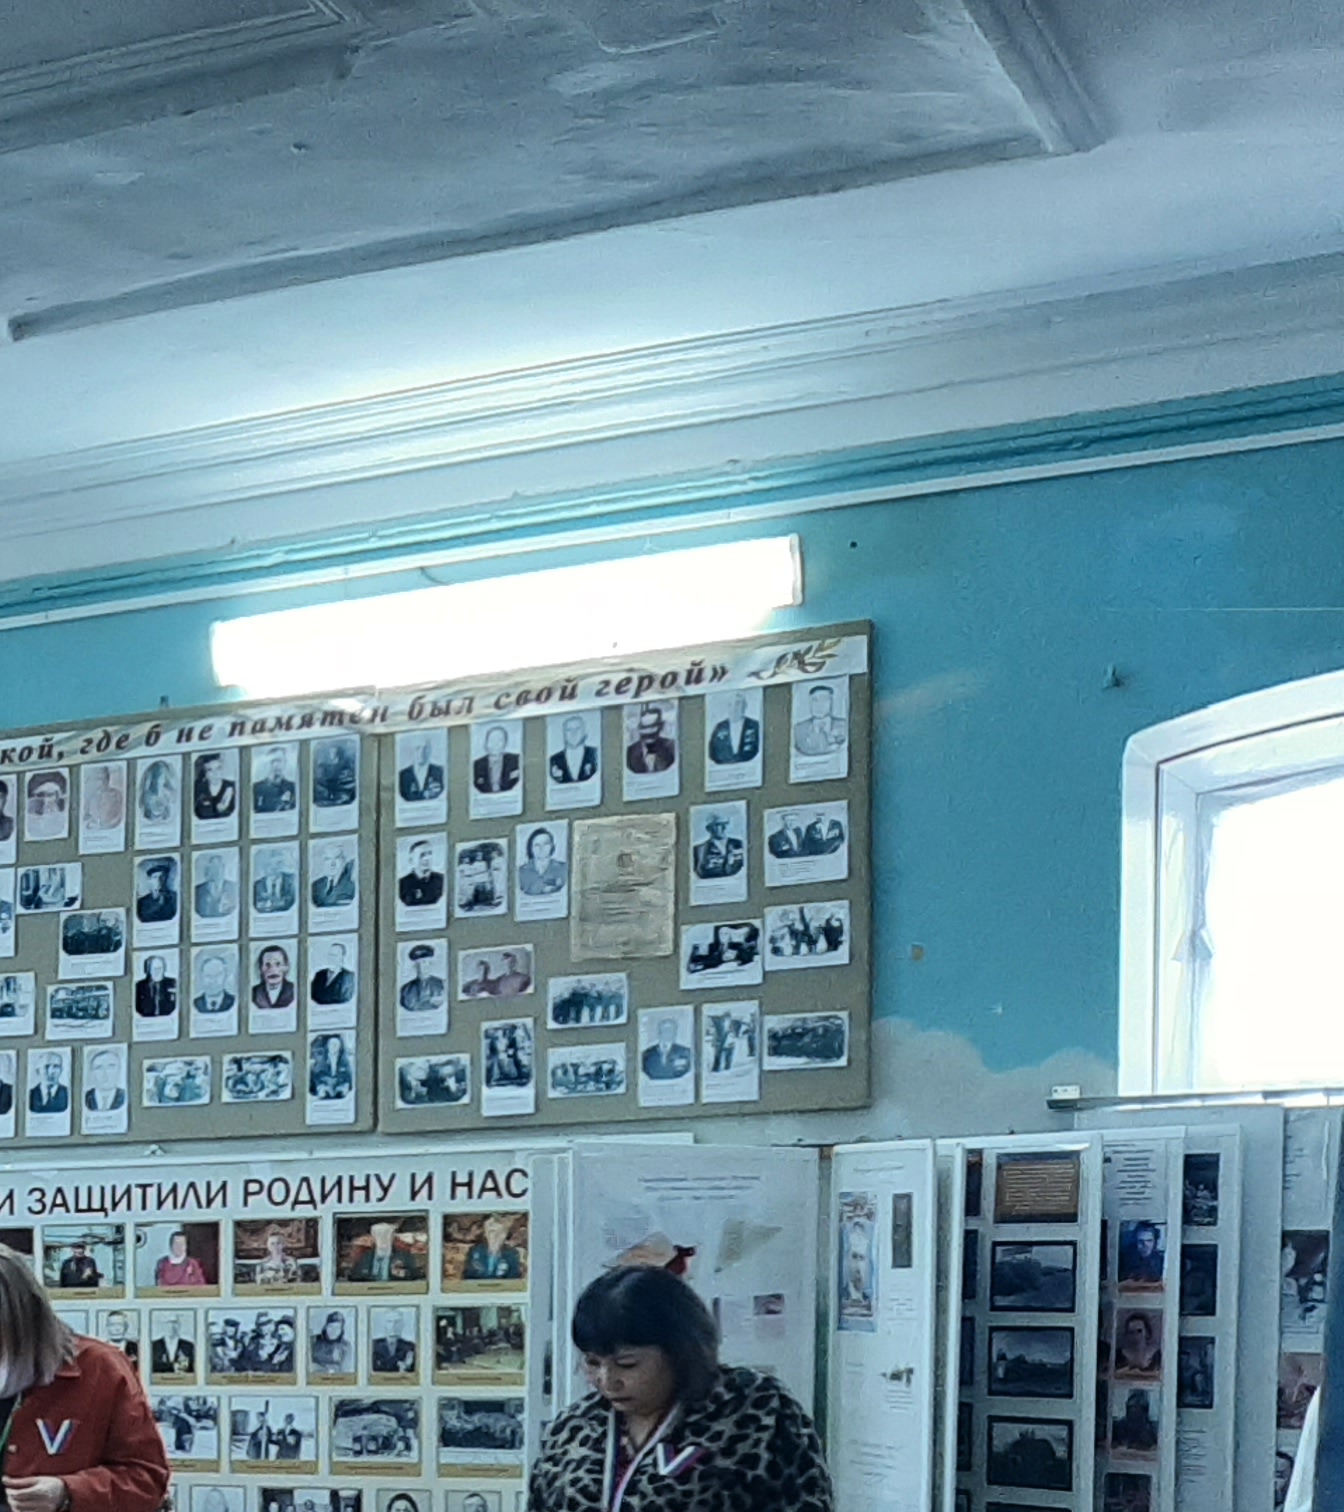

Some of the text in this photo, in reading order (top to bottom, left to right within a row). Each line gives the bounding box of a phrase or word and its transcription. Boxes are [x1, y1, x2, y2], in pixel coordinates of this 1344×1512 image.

[79, 730, 130, 756] где
[145, 722, 162, 748] б
[175, 721, 213, 745] не
[227, 705, 389, 740] памятен
[407, 695, 475, 723] был
[493, 676, 579, 711] свой
[595, 658, 730, 700] герой»
[26, 1179, 229, 1216] ЗАЩИТИЛИ
[242, 1172, 397, 1210] РОДИНУ
[411, 1171, 435, 1202] И
[449, 1168, 530, 1201] НАС
